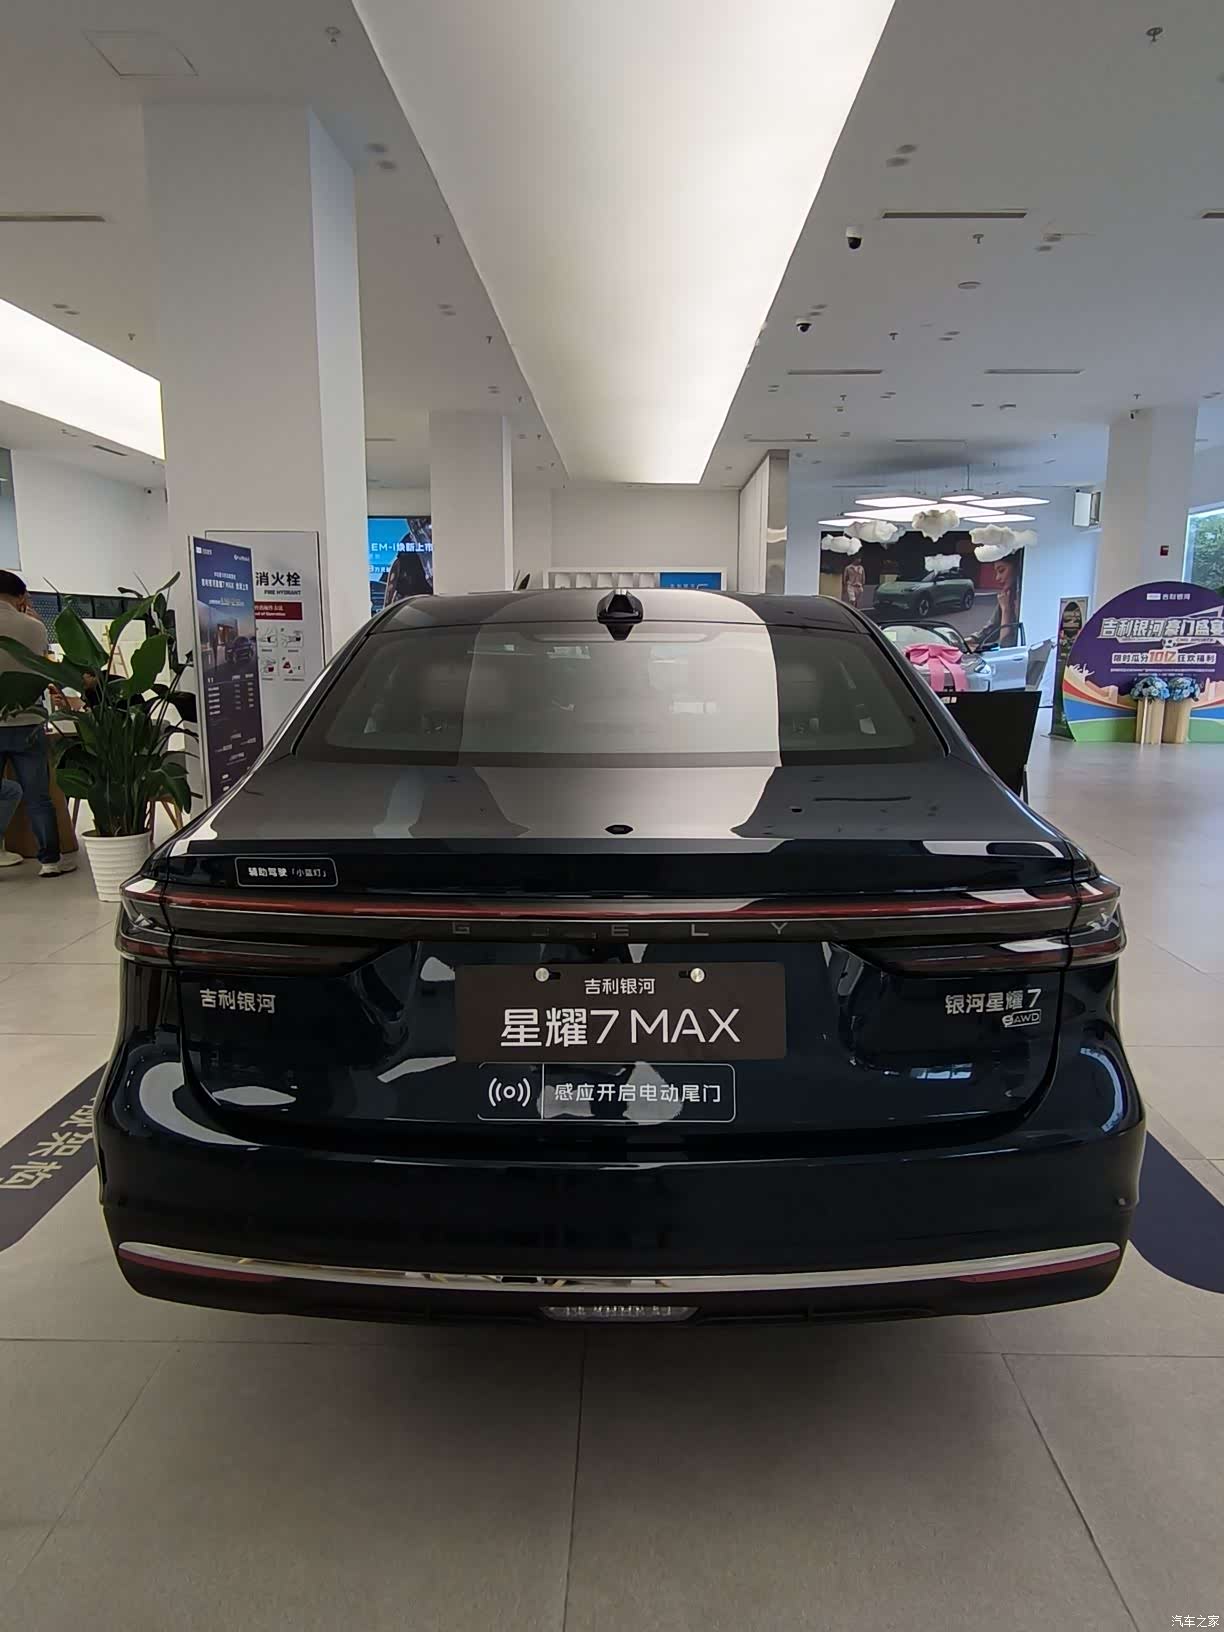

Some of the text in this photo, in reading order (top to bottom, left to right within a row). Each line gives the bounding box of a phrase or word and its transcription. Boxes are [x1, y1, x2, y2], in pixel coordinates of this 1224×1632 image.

[255, 571, 301, 587] 消火栓
[584, 978, 655, 995] 吉利银河
[200, 988, 276, 1014] 吉利银河
[945, 989, 1042, 1015] 银河星耀7
[554, 1084, 721, 1103] 感应开启电动尾门
